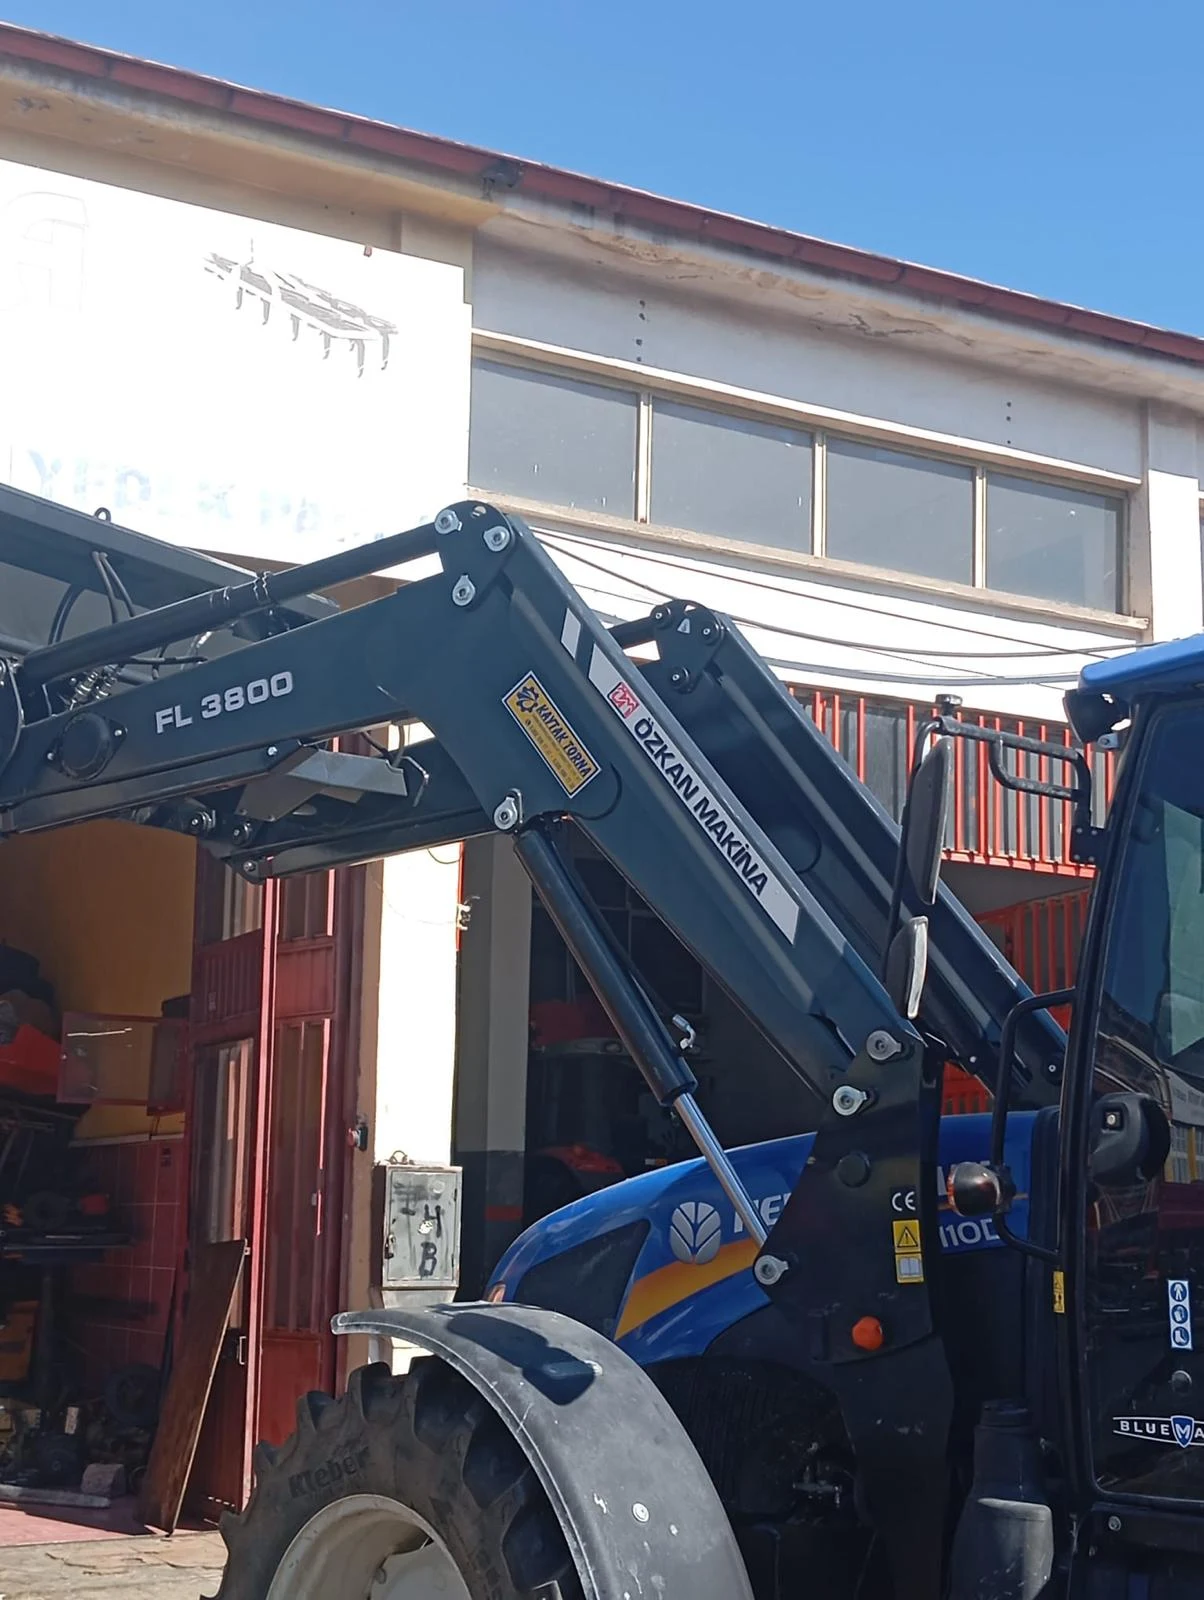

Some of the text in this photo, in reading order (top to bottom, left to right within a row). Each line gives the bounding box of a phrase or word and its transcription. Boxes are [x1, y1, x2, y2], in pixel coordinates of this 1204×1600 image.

[155, 671, 294, 734] FL 3800
[536, 704, 568, 742] KAYTAK
[563, 741, 592, 778] TORNA
[634, 717, 769, 896] ÖZKAN MAKİNA
[892, 1191, 916, 1211] CE
[288, 1445, 371, 1498] Kleber
